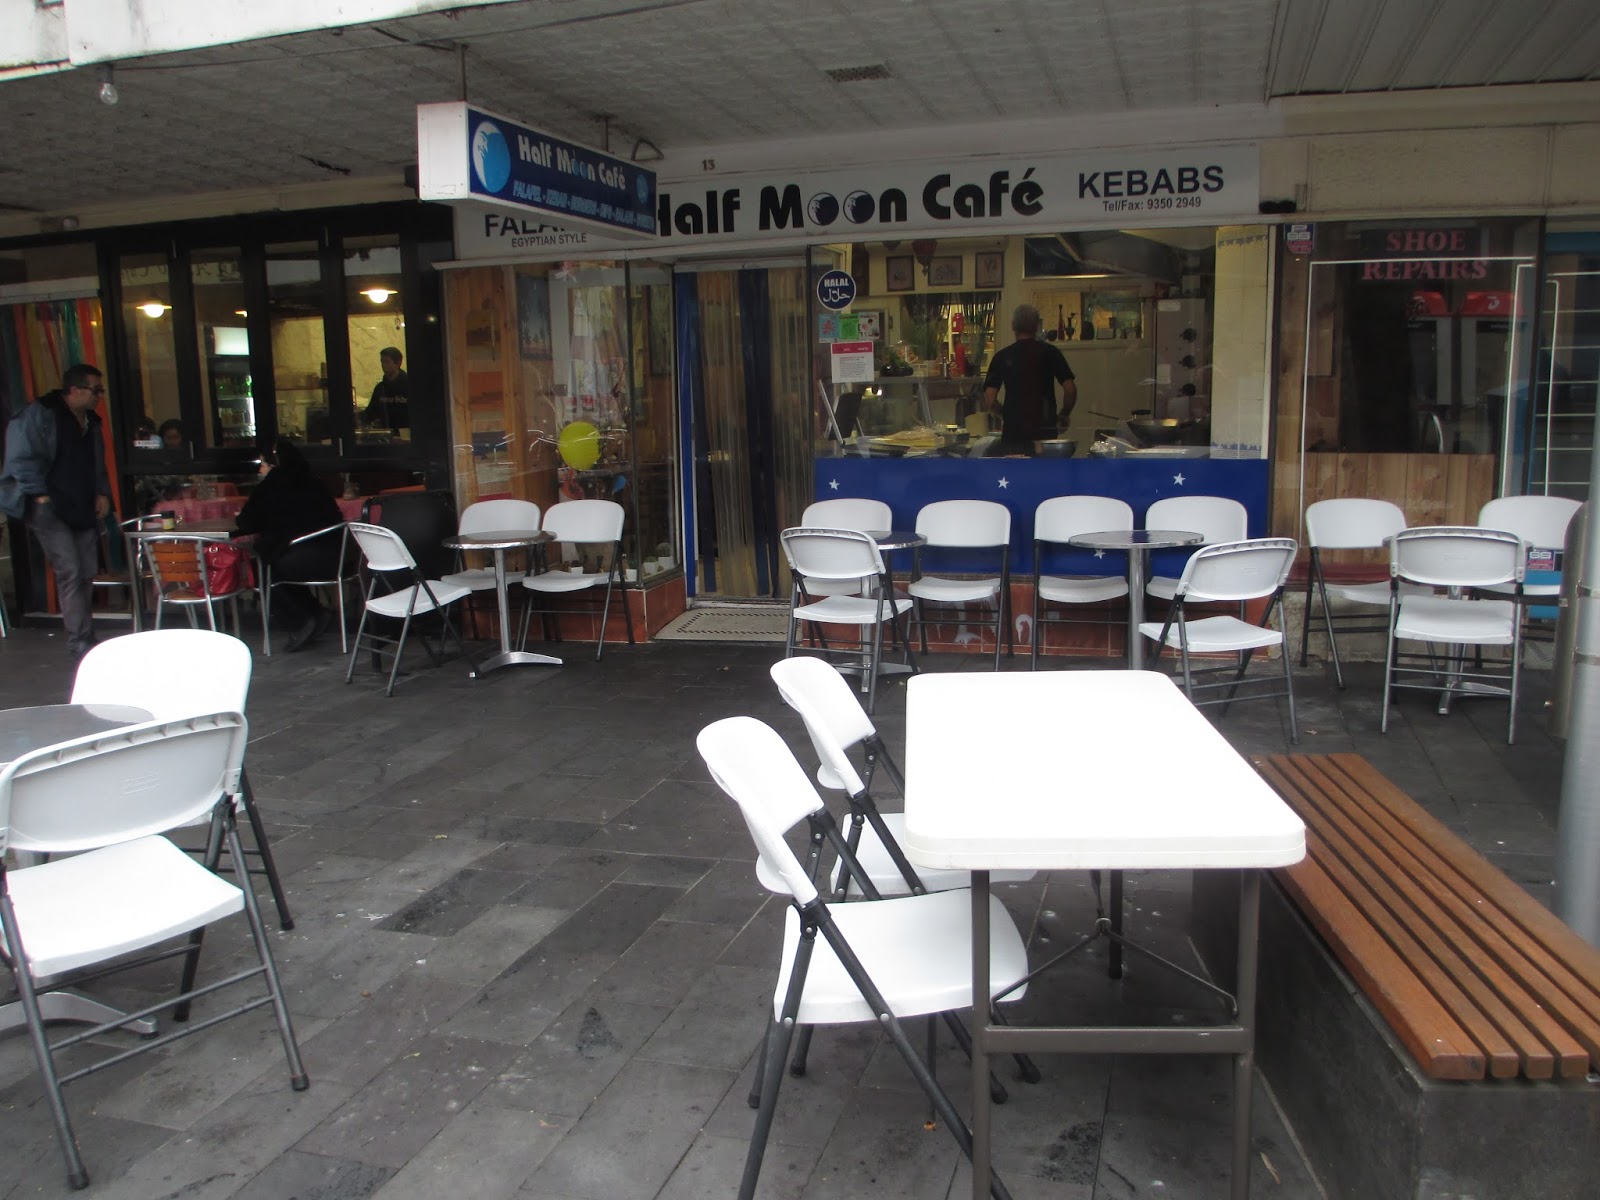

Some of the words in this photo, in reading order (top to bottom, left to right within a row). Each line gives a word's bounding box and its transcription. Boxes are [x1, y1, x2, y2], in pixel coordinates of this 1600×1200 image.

[518, 134, 552, 168] Half
[598, 163, 626, 191] Café
[702, 159, 716, 171] 13
[1078, 165, 1225, 199] KEBABS
[758, 183, 908, 231] Moon
[922, 167, 1044, 220] Café
[1102, 199, 1144, 212] Tel/Fax:
[1147, 198, 1173, 210] 9350
[1176, 197, 1202, 209] 2949
[511, 234, 556, 248] EGYPTIAN
[558, 232, 588, 245] STYLE
[1385, 230, 1466, 252] SHOE
[1361, 258, 1488, 280] REPAIRS
[824, 278, 849, 287] HALAL
[823, 288, 850, 302] حلال
